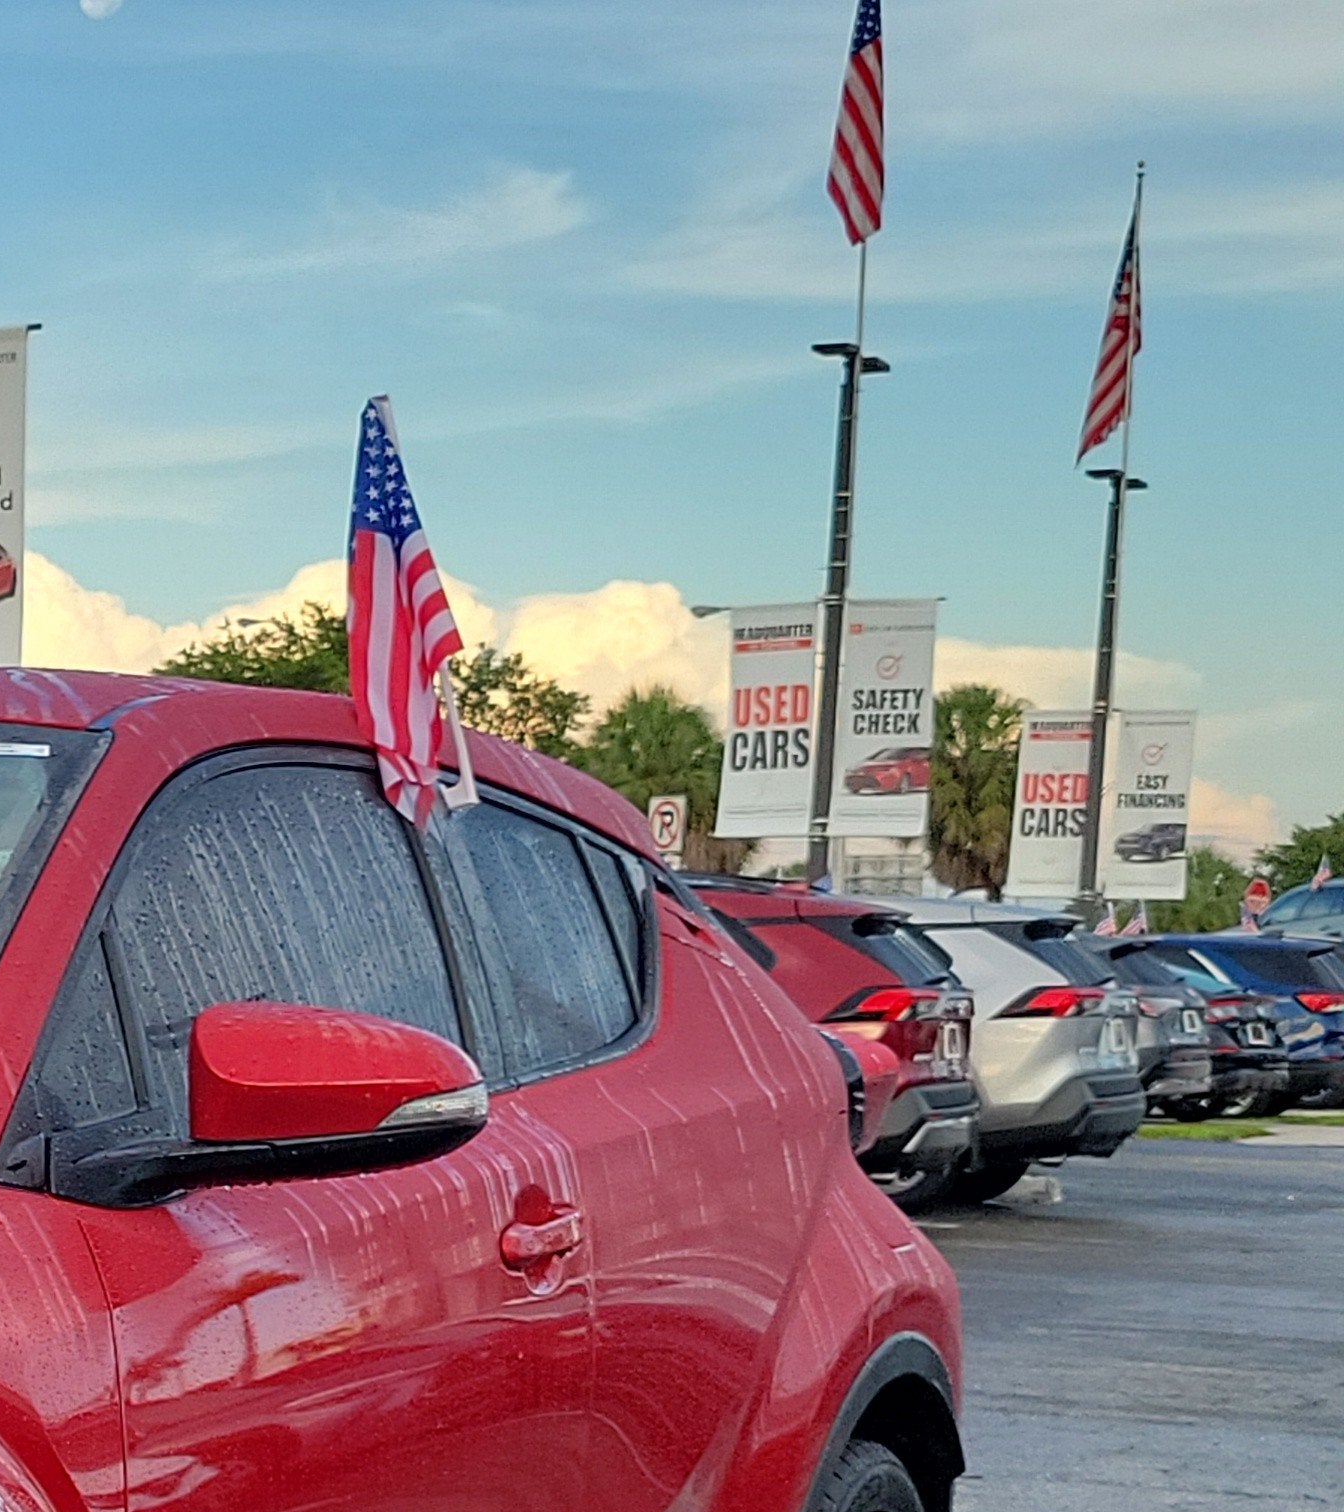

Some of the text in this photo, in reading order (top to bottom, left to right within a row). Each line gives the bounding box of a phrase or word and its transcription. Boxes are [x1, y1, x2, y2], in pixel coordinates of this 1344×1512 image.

[734, 685, 810, 727] USED
[852, 688, 925, 711] SAFETY
[853, 713, 920, 735] CHECK
[731, 728, 811, 771] CARS
[1023, 773, 1089, 804] USED
[1021, 808, 1088, 837] CARS
